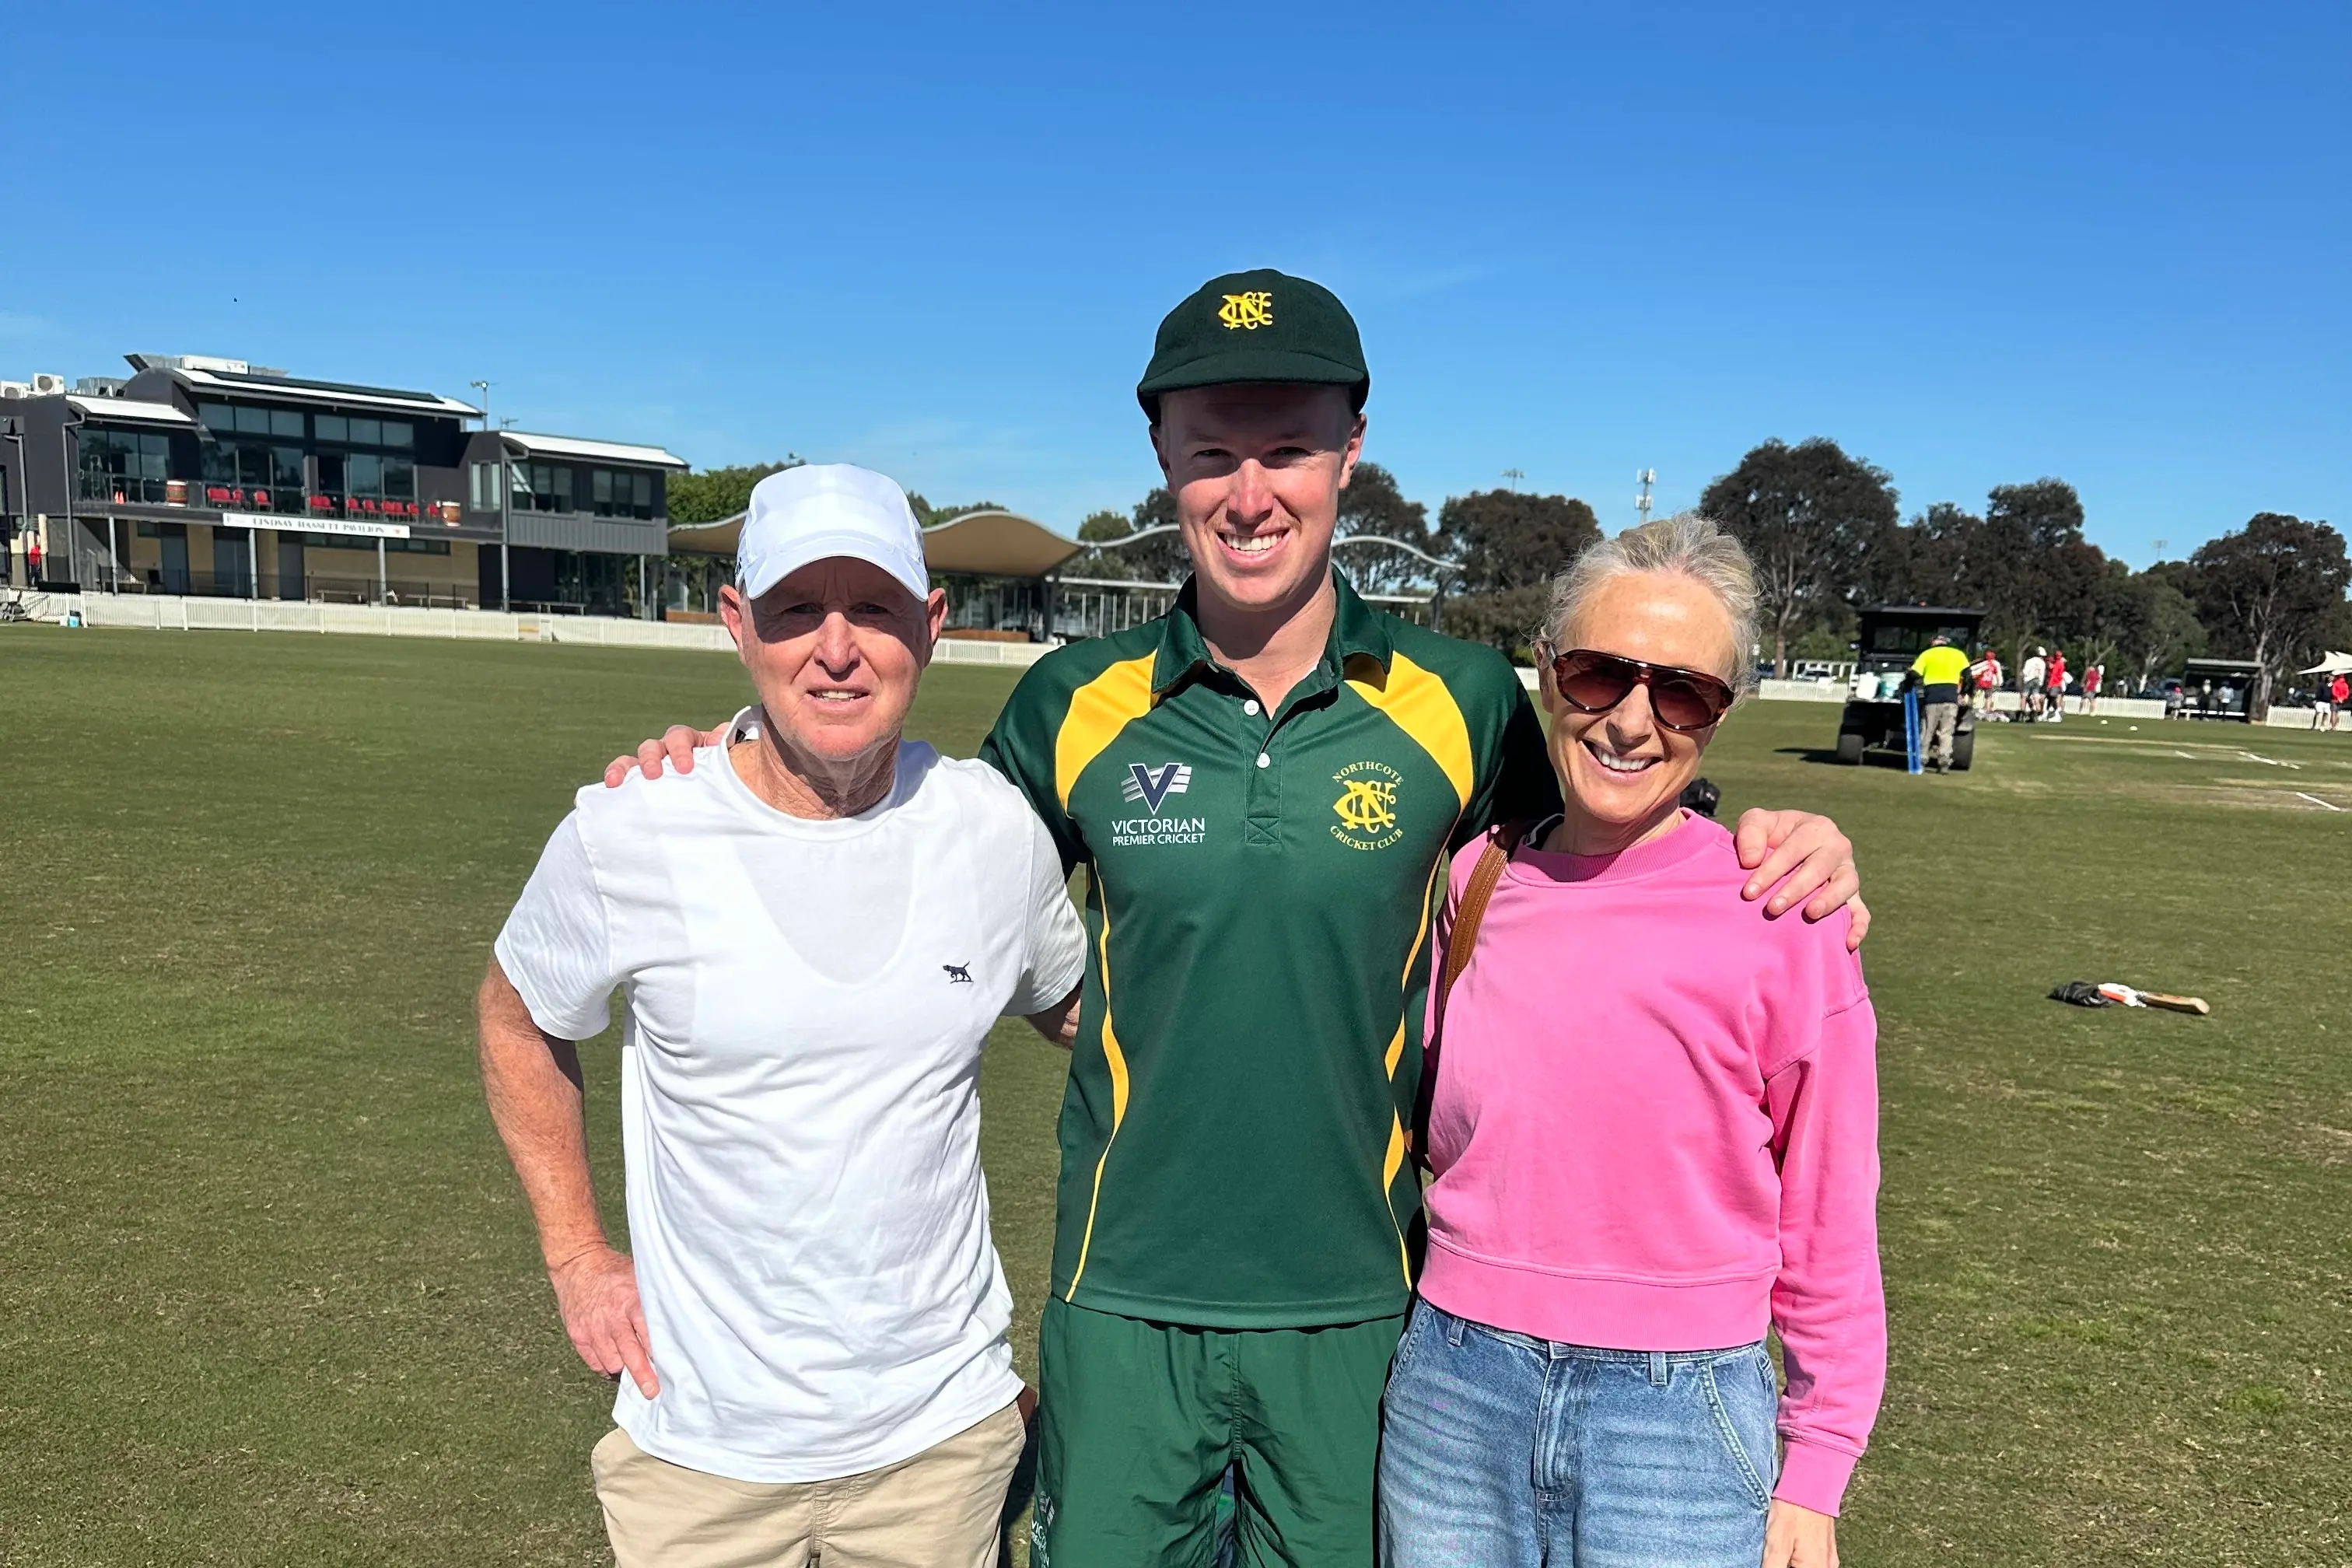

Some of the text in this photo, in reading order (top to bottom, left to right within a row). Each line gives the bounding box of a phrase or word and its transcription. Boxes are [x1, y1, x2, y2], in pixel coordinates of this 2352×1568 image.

[1332, 761, 1404, 786] NORTHCOTE
[1111, 817, 1206, 835] VICTORIAN
[1112, 833, 1206, 847] PREMIER CRICKET
[1330, 825, 1403, 850] CRICKET CLUB
